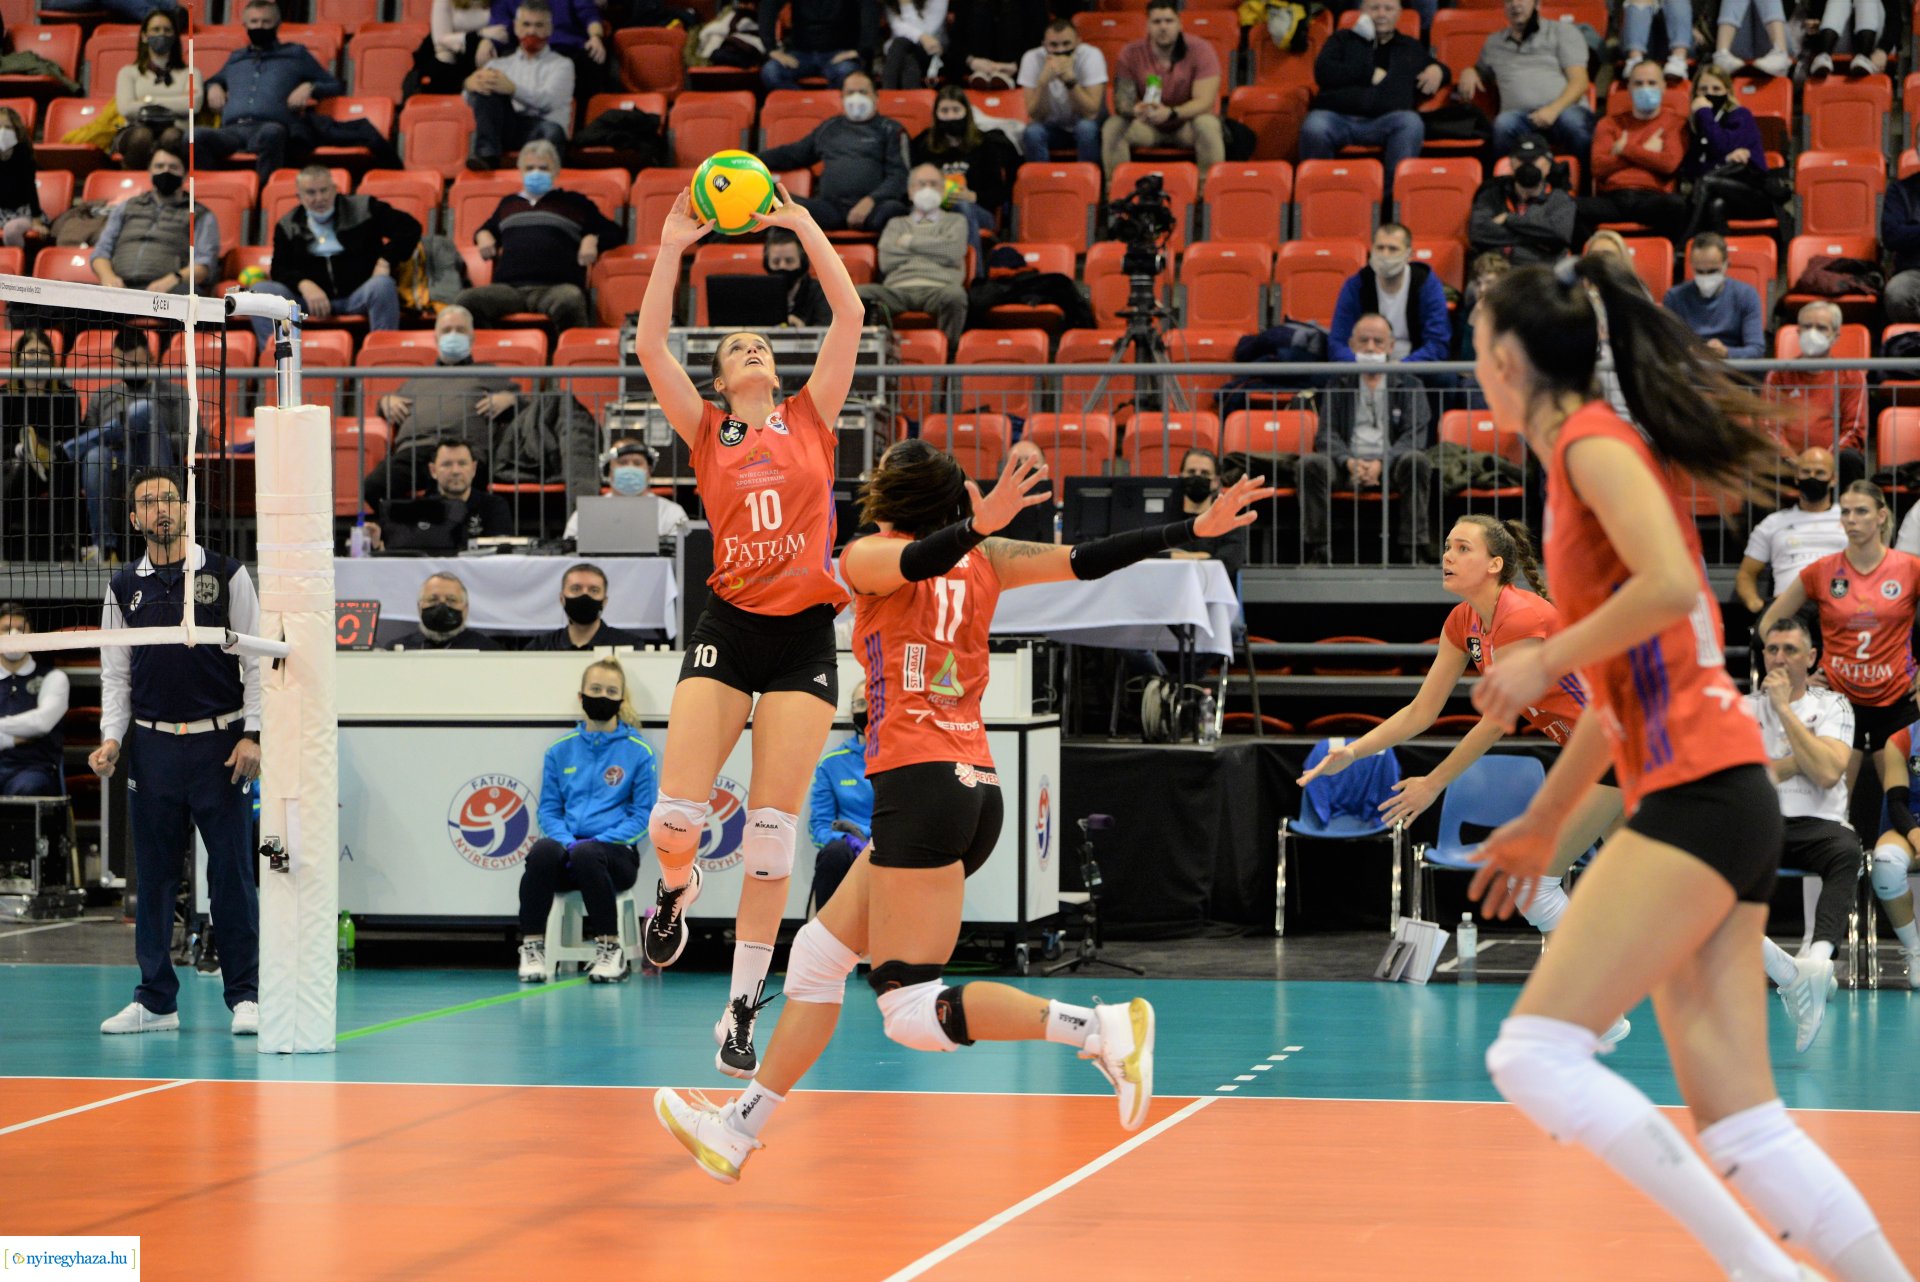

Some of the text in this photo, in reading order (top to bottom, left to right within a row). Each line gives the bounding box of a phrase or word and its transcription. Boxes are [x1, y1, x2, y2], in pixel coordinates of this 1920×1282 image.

[745, 489, 783, 532] 10
[935, 576, 966, 643] 17
[693, 643, 718, 668] 10
[1855, 630, 1872, 660] 2
[471, 776, 518, 790] FATUM
